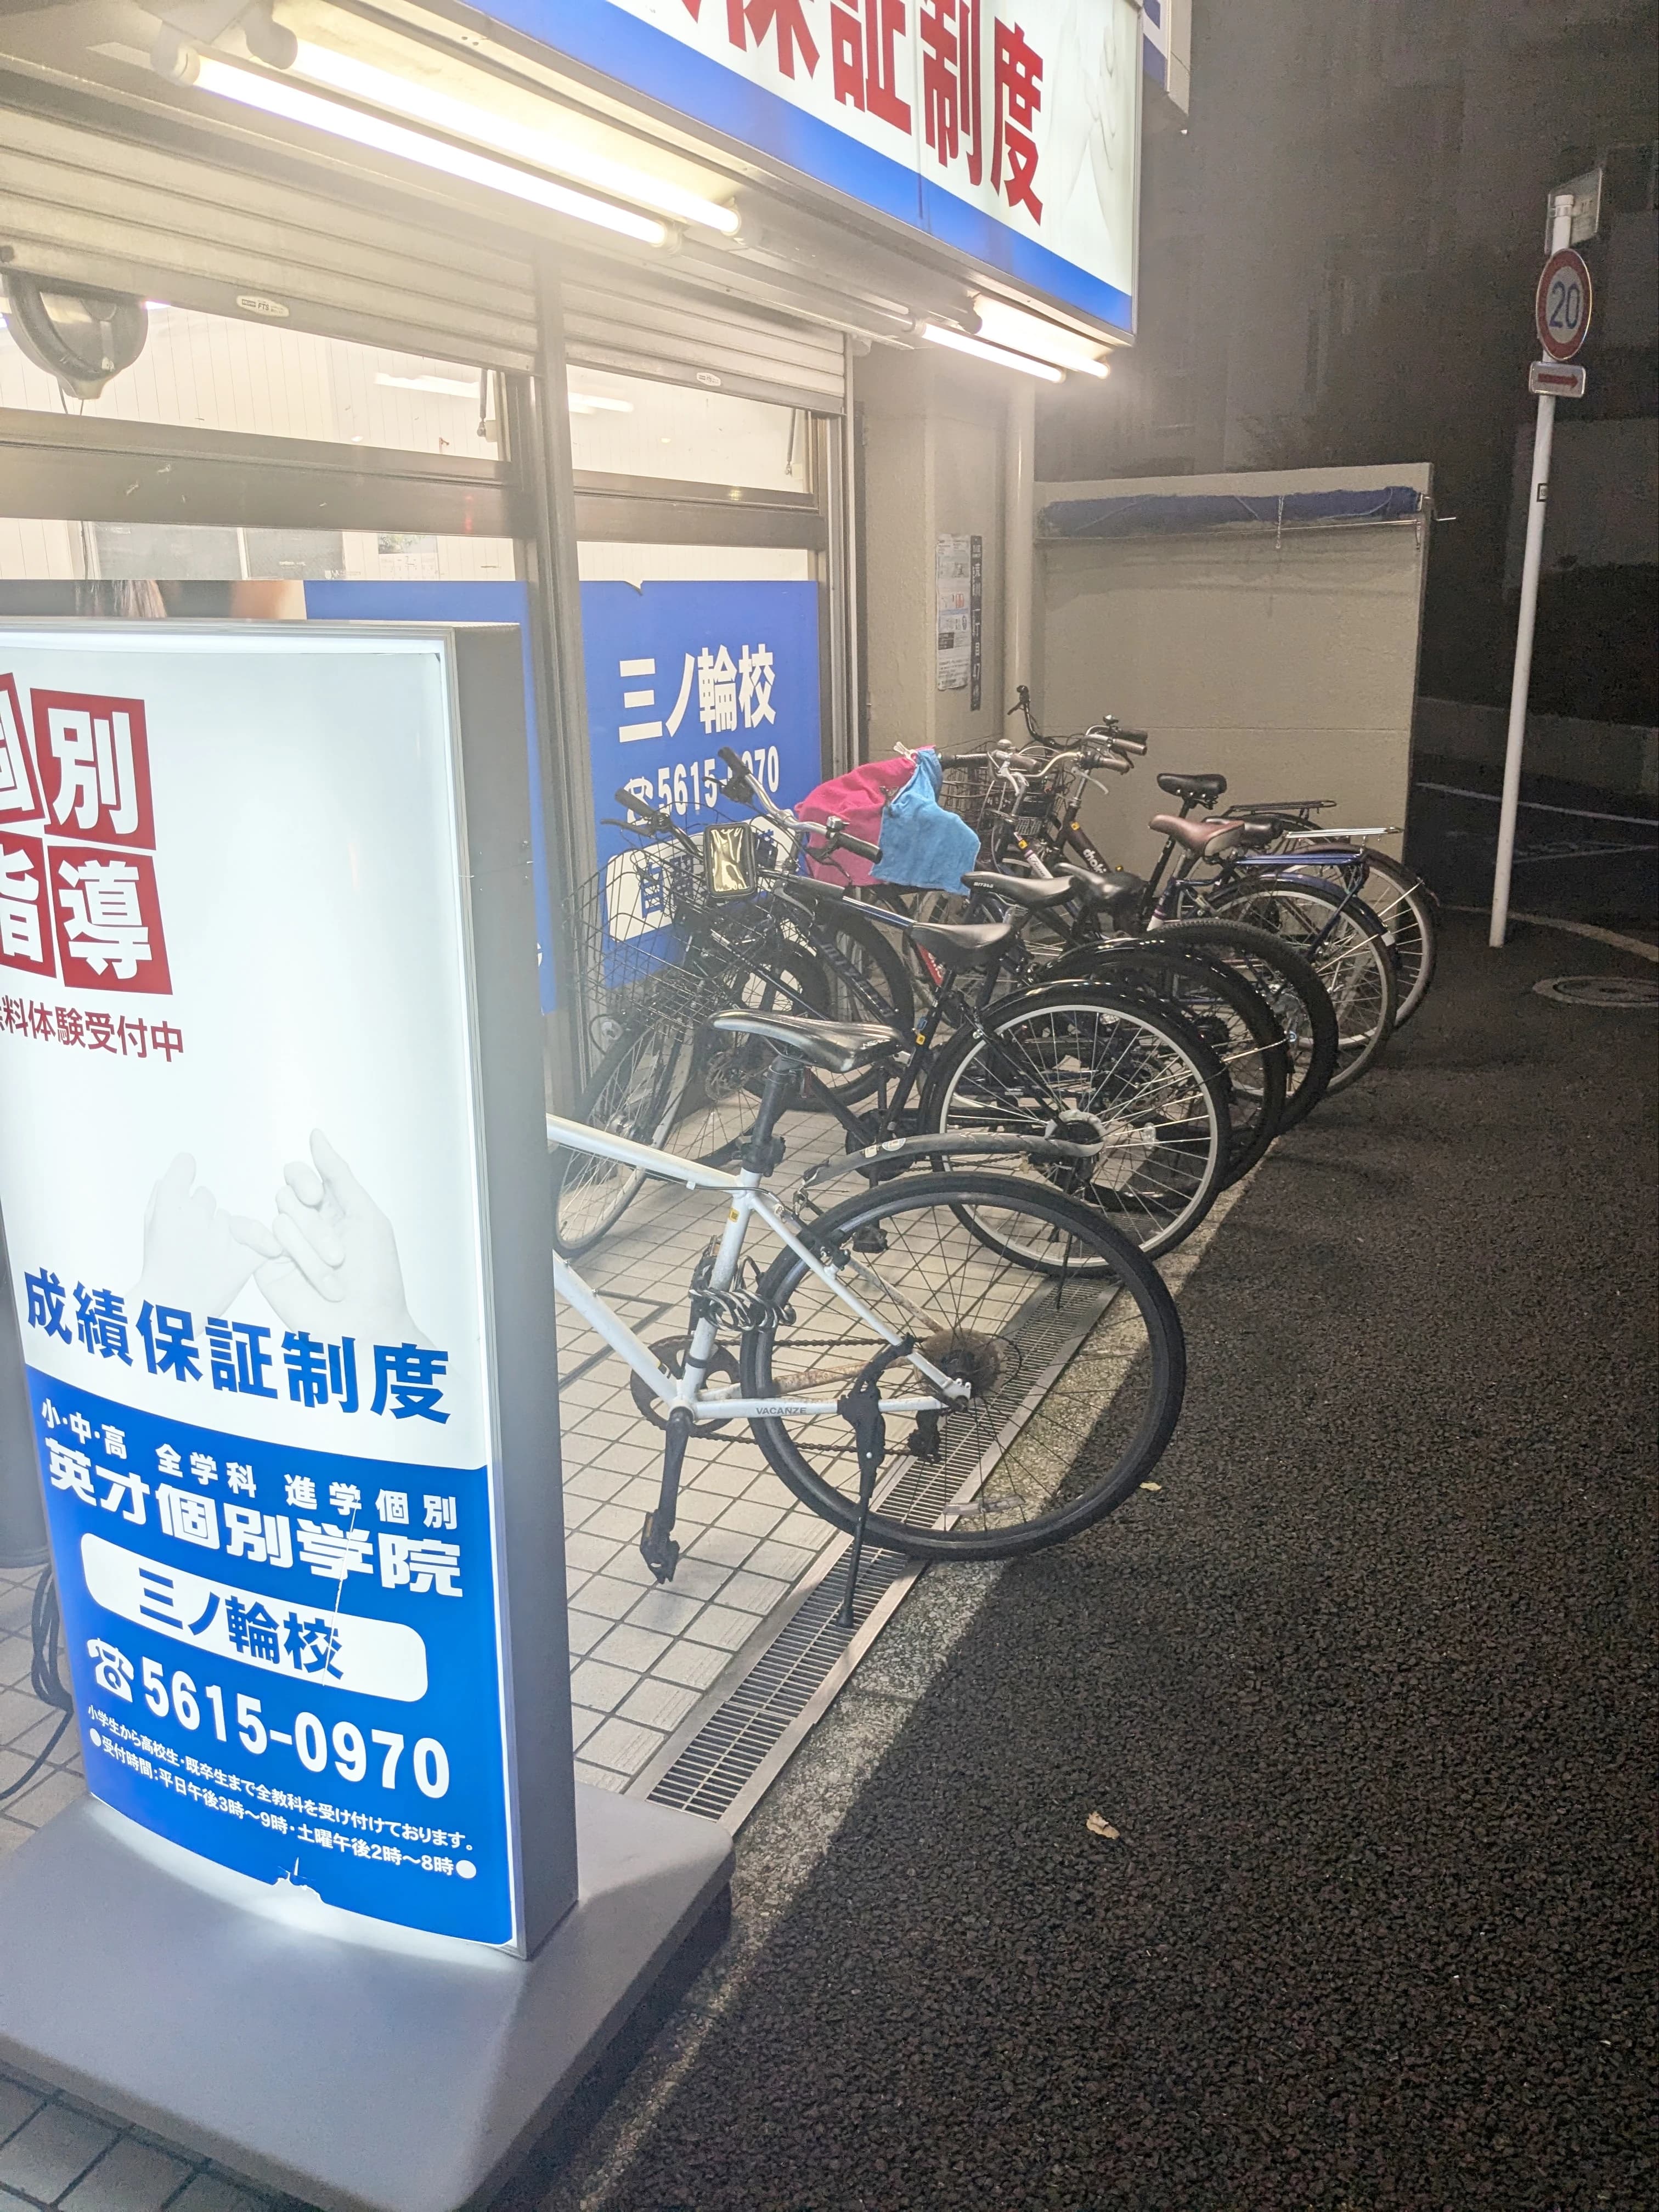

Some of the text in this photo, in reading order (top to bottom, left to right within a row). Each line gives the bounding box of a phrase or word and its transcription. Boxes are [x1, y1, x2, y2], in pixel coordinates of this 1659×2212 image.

[1549, 280, 1580, 330] 20
[618, 643, 776, 743] 三ノ輪校
[658, 746, 779, 816] 5615-70
[0, 995, 184, 1062] 料体験受付中
[24, 1267, 451, 1424] 成績保証制度
[755, 1406, 808, 1415] VACANZE
[45, 1437, 464, 1598] 英才個別学院
[156, 1442, 257, 1498] 全学科
[285, 1474, 458, 1531] 進学個別
[138, 1566, 345, 1680] 三ノ輪校
[142, 1656, 450, 1799] 5615-0970
